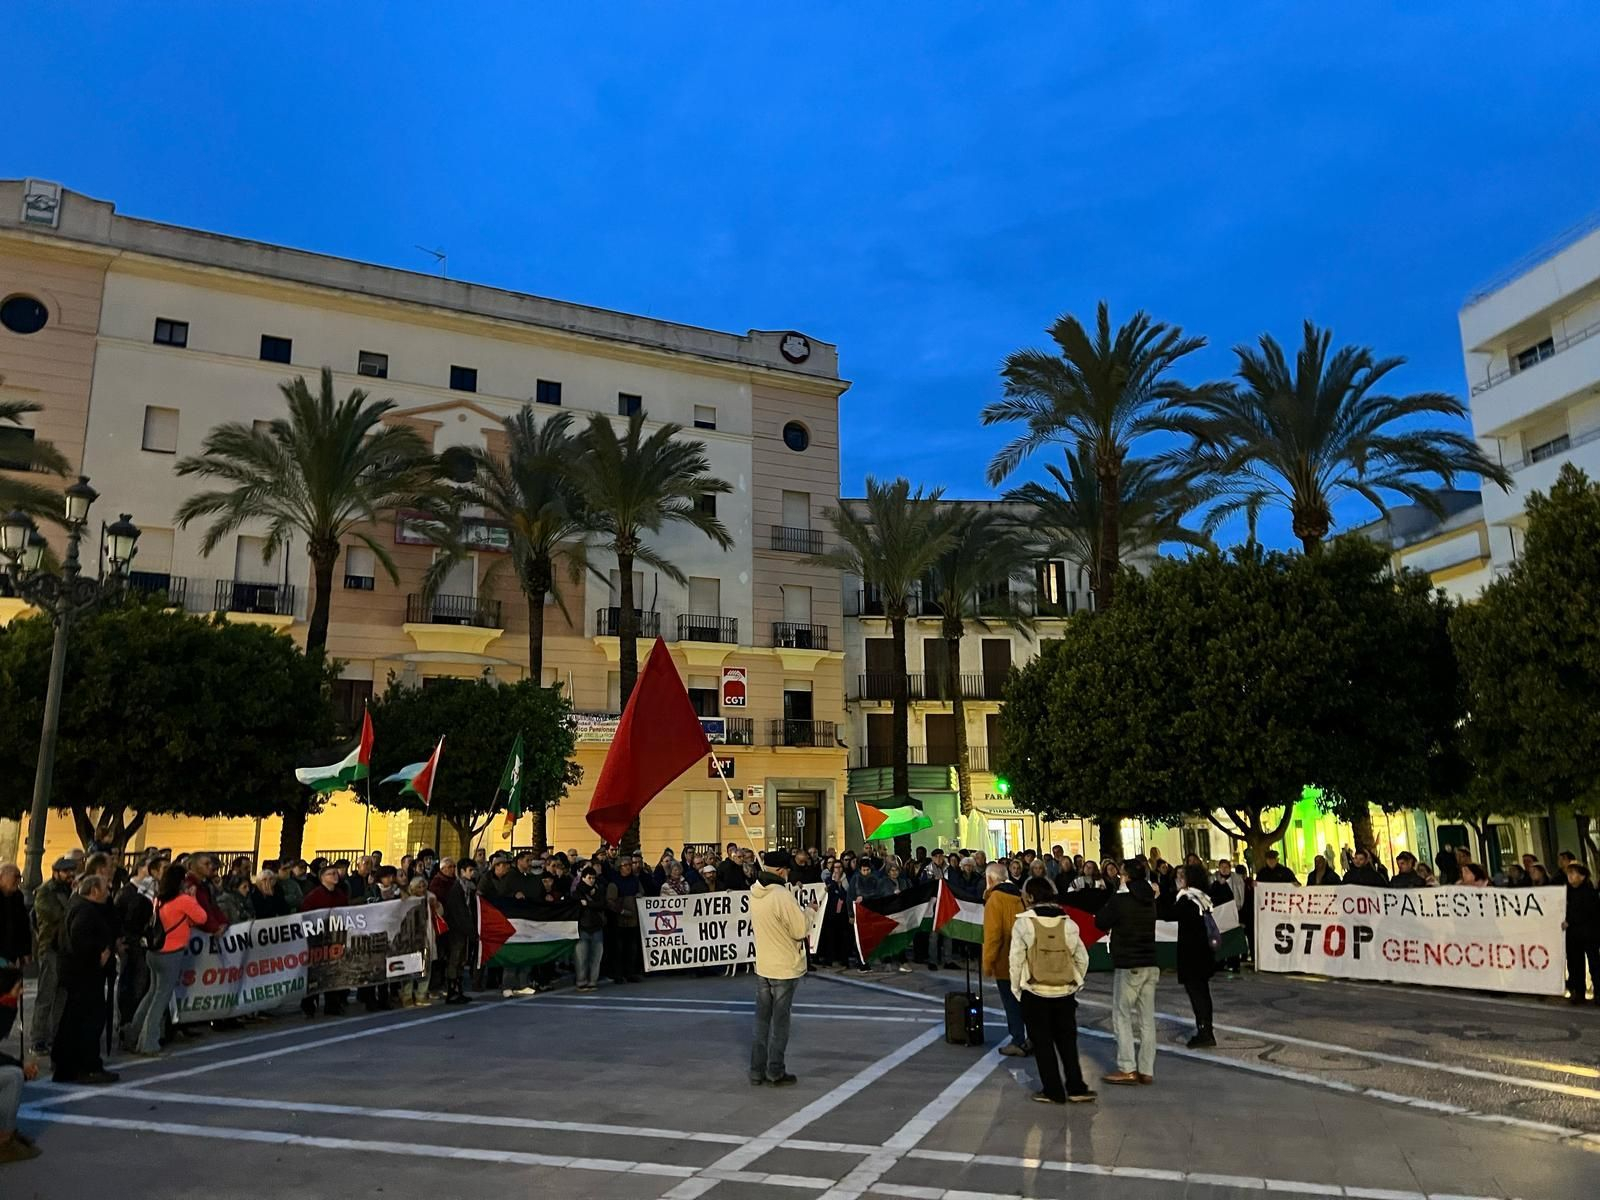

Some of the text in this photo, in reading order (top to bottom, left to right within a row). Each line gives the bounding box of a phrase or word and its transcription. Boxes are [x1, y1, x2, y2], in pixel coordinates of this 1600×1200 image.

[725, 696, 745, 705] CGT
[711, 760, 732, 769] CNT
[645, 897, 689, 910] BOICOT
[693, 896, 731, 917] AYER
[1260, 891, 1545, 917] JEREZ CON PALESTINA
[183, 935, 204, 956] O
[257, 919, 325, 945] GUERRA
[329, 911, 367, 932] MÁS
[645, 935, 689, 948] ISRAEL
[698, 920, 728, 941] HOY
[1273, 922, 1374, 960] STOP
[649, 943, 738, 967] SANCIONES
[1382, 938, 1551, 971] GENOCIDIO
[242, 976, 305, 1004] LIBERTAD
